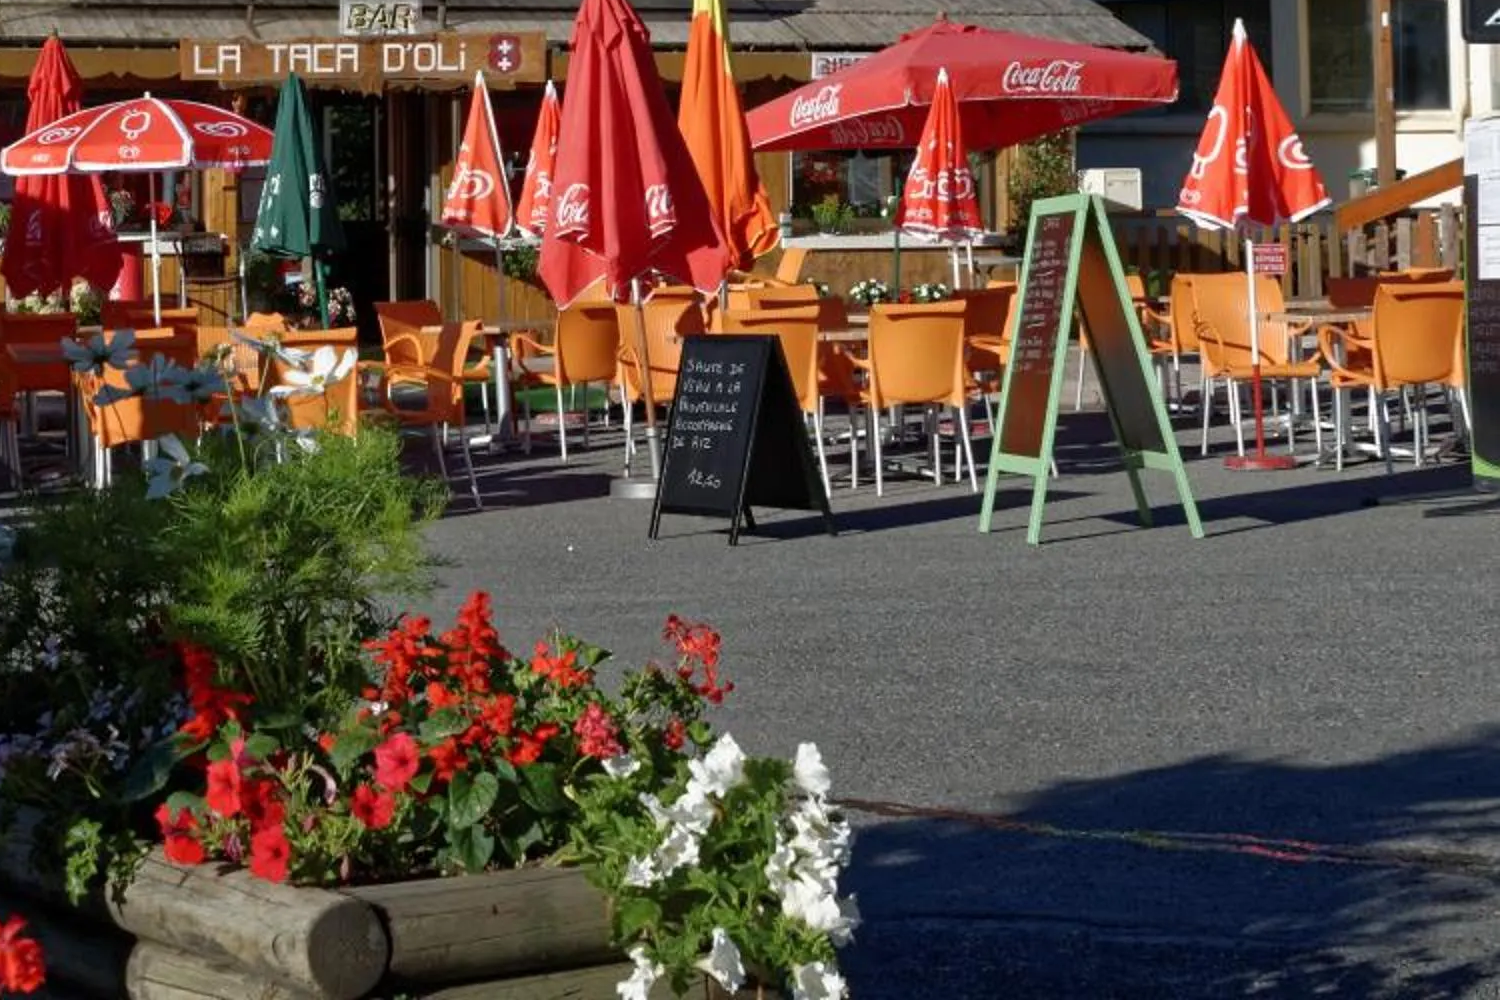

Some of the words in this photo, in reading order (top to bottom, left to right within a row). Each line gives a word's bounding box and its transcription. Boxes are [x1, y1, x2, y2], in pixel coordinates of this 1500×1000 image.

[346, 3, 414, 30] BAR
[193, 43, 242, 74] LA
[266, 43, 359, 73] TACA
[1002, 60, 1086, 93] Coca-Cola
